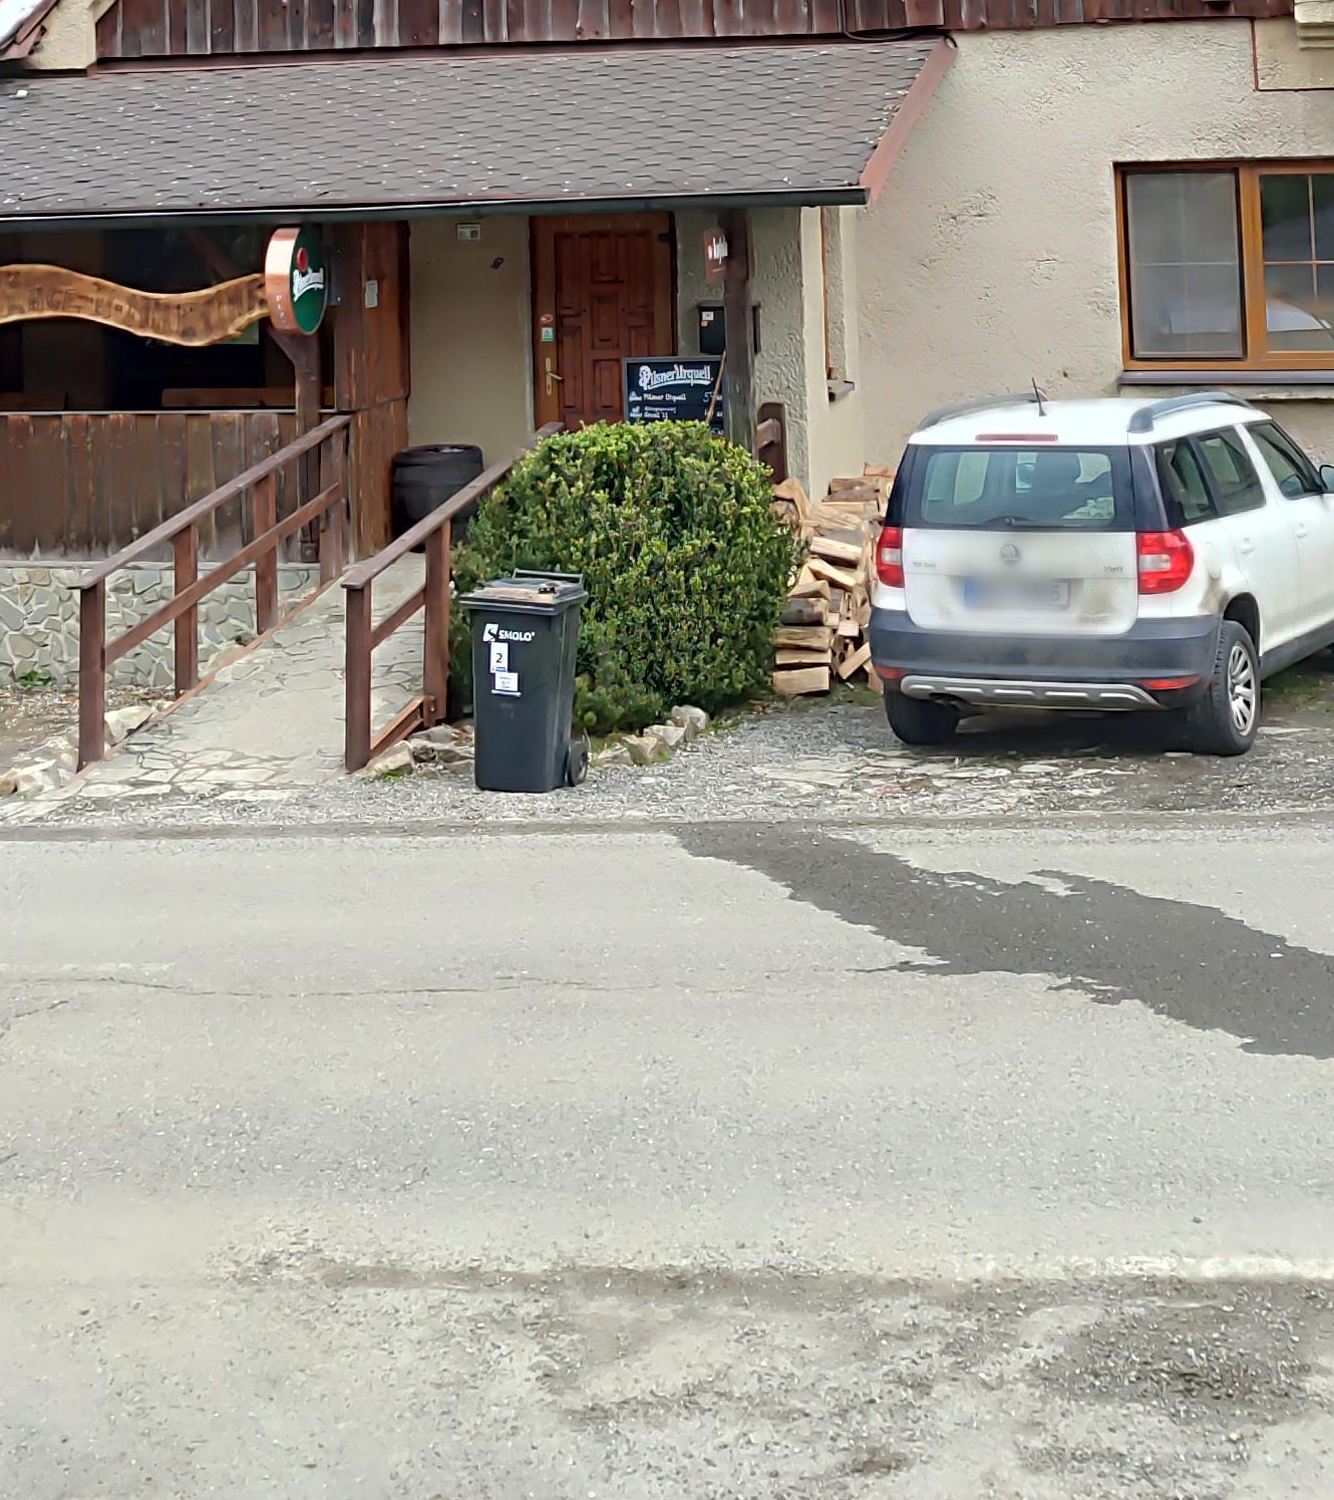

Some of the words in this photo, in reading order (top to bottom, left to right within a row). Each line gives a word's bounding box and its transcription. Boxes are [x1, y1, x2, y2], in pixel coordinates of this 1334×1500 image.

[639, 365, 676, 390] Pilsner
[674, 364, 711, 386] Urquell
[498, 630, 532, 641] SMOLO
[496, 652, 503, 663] 2
